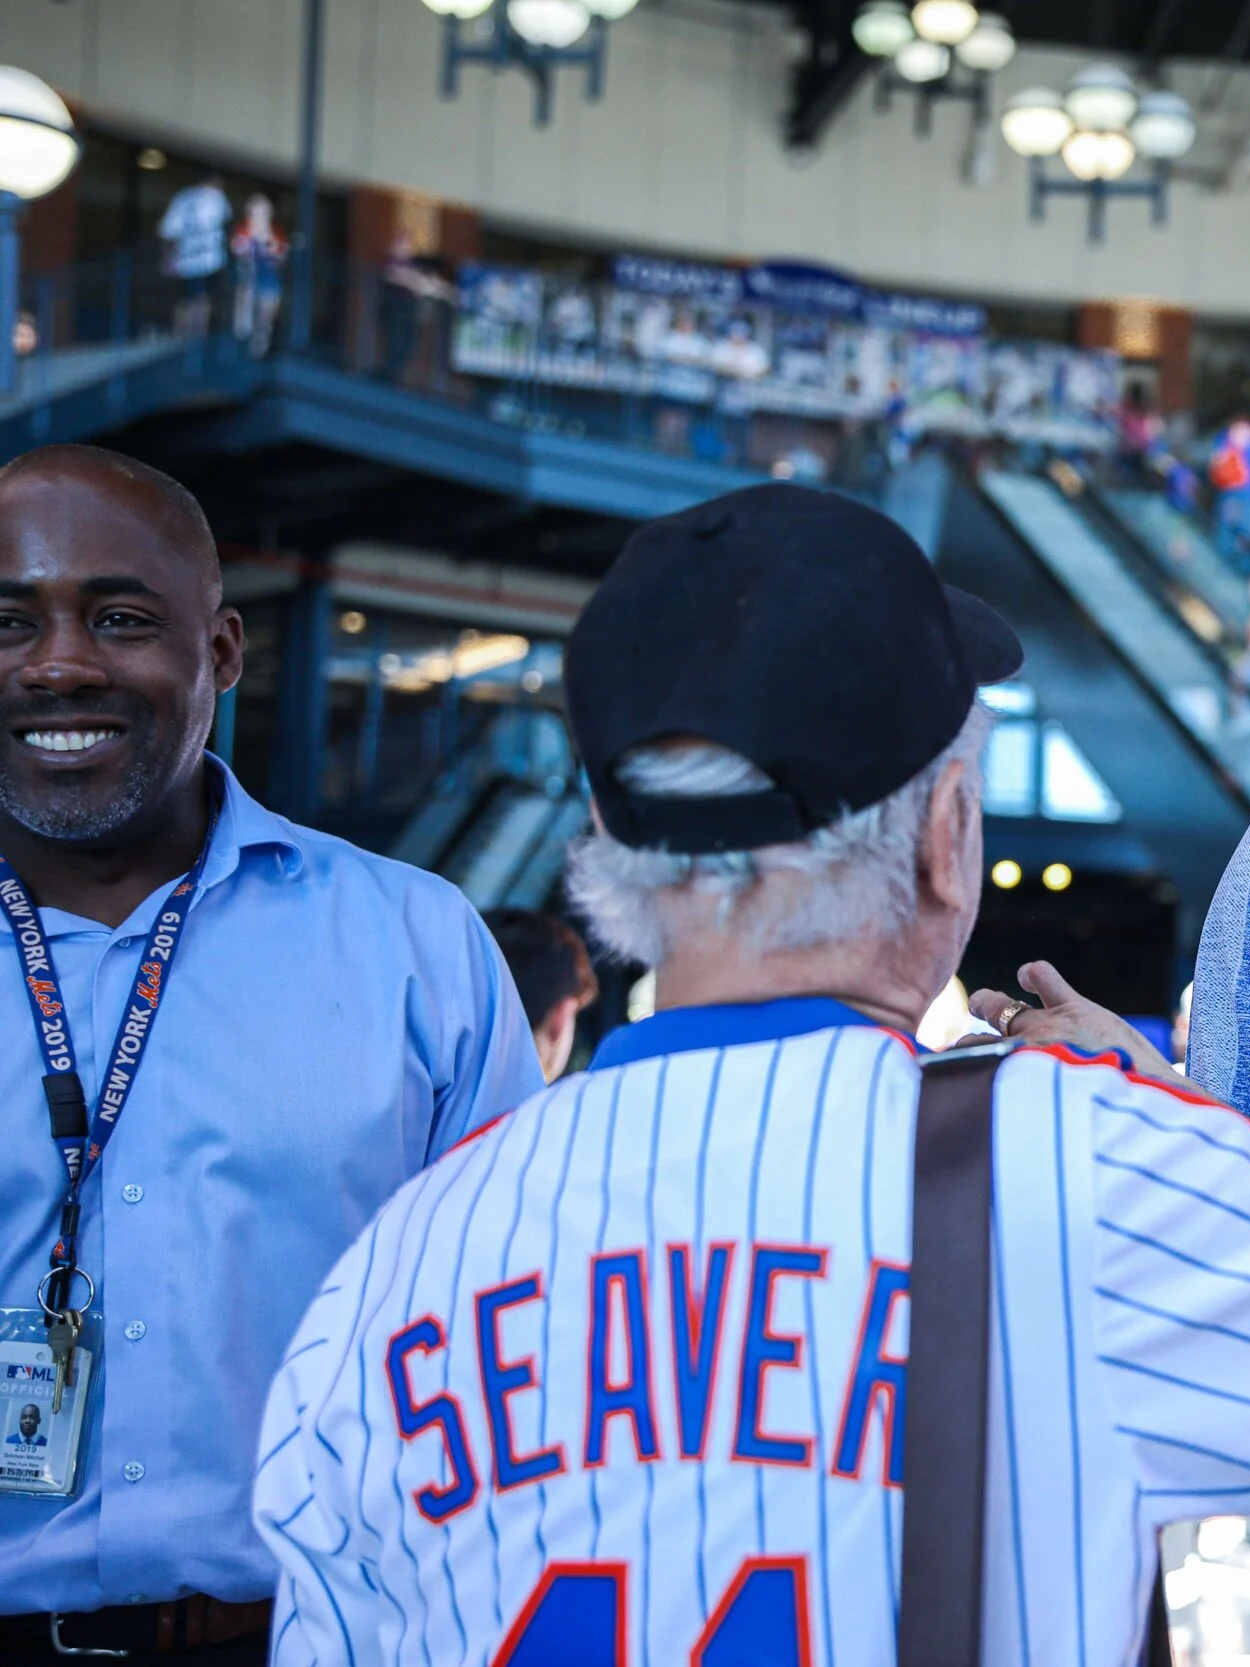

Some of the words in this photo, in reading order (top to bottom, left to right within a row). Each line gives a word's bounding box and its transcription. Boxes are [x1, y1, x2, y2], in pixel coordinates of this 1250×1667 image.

[0, 878, 33, 917] NEW
[17, 918, 50, 974] YORK
[27, 975, 63, 1017] Mets
[99, 1066, 130, 1123] NEW
[121, 1004, 151, 1066] YORK
[137, 961, 162, 1009] Mets
[150, 911, 181, 961] 2019
[41, 1019, 71, 1072] 2019
[64, 1147, 80, 1179] NE
[0, 1382, 69, 1398] OFFICIL
[14, 1445, 38, 1453] 2019
